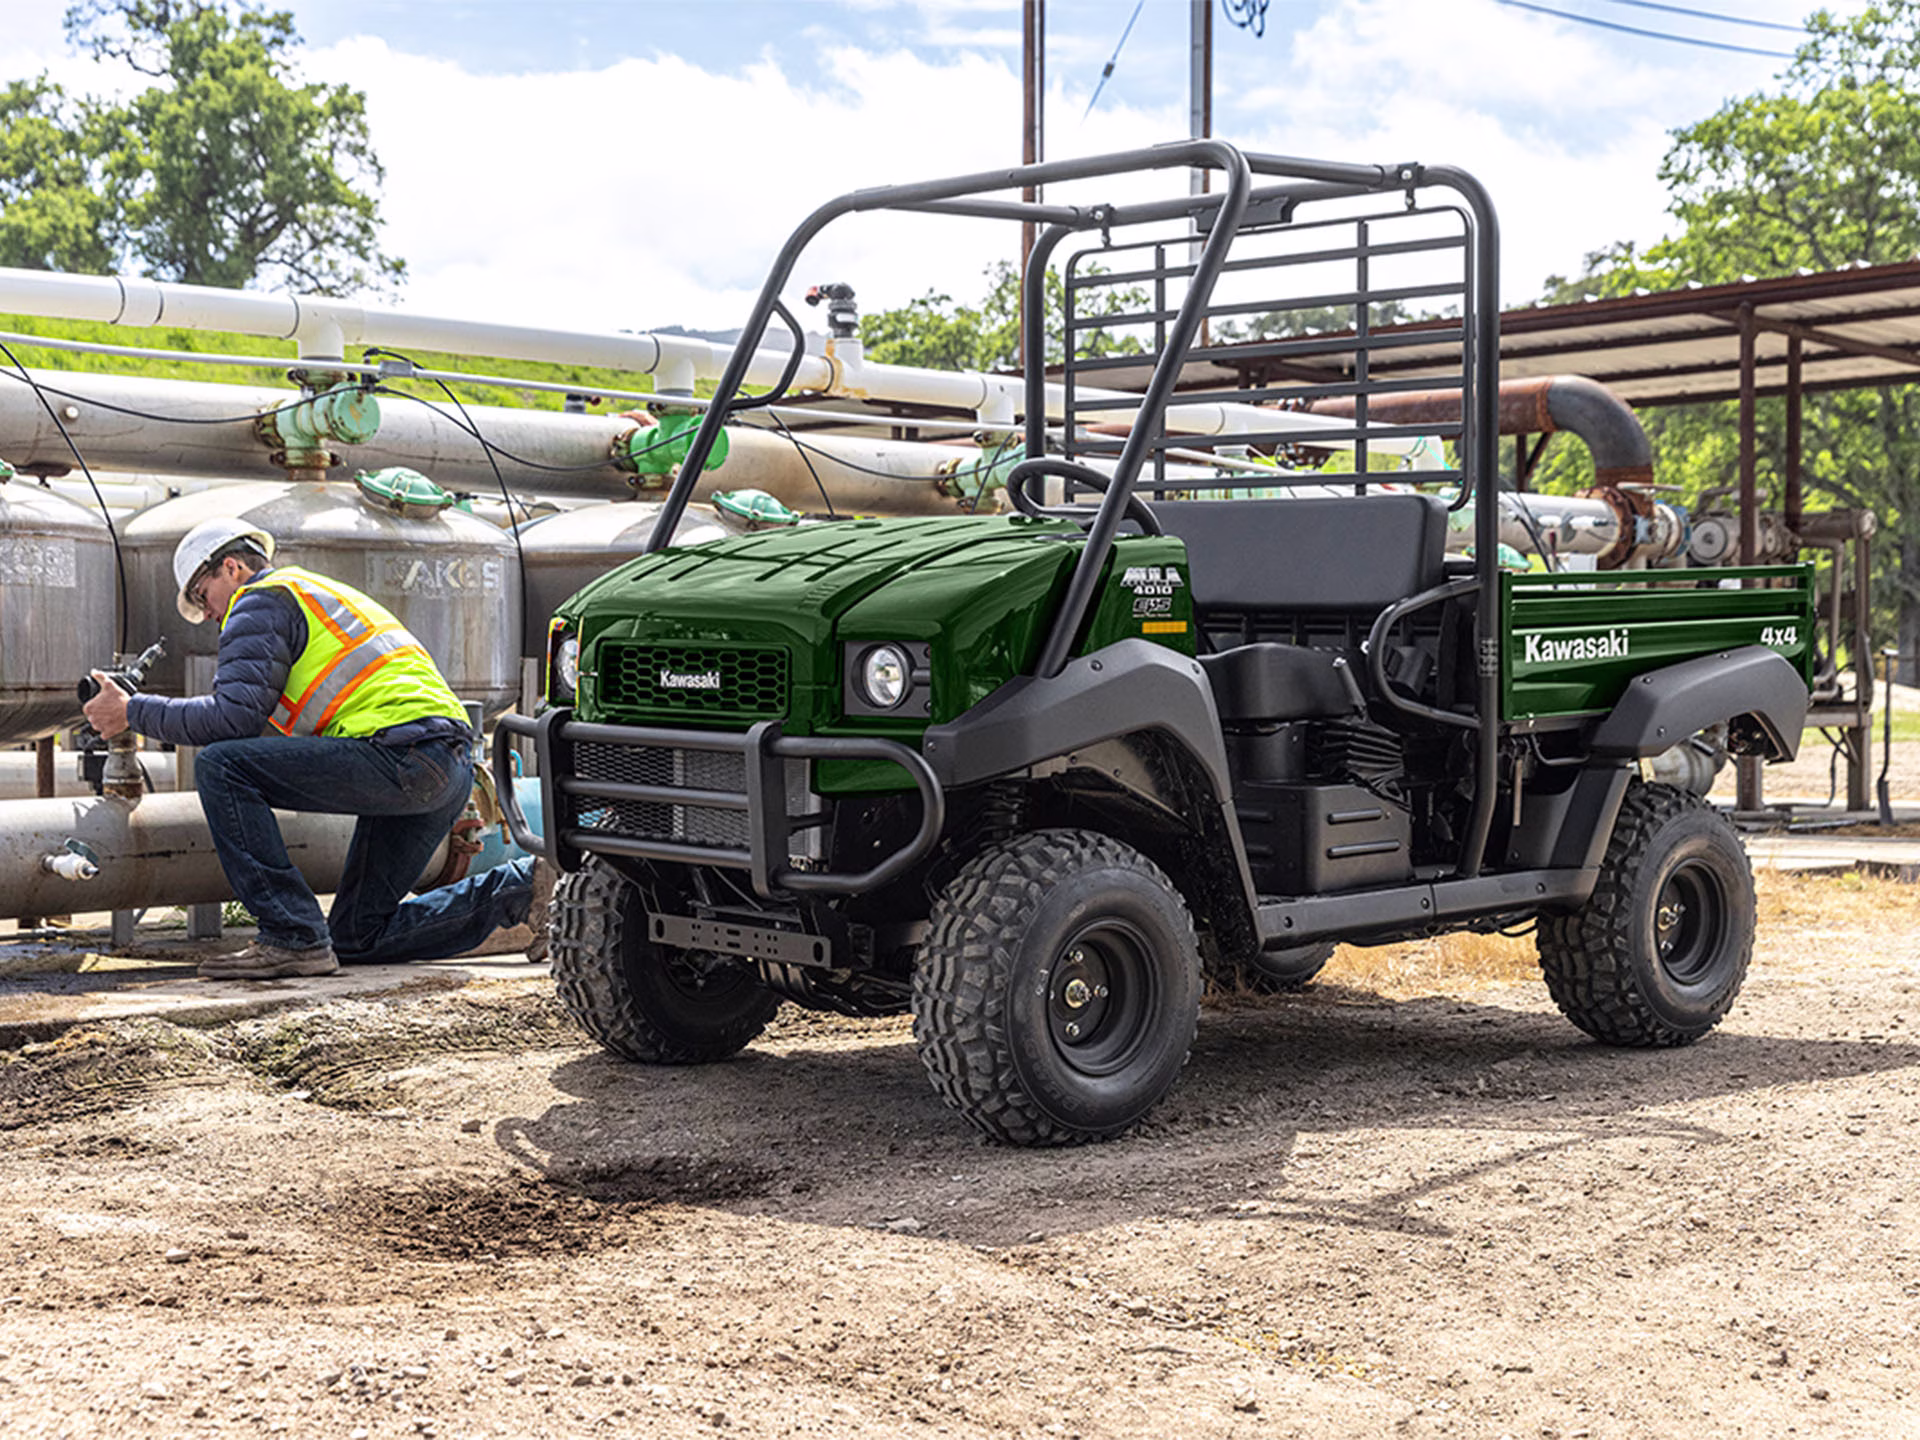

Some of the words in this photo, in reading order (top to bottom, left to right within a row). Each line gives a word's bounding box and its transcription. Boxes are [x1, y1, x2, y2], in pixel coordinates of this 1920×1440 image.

[1133, 585, 1173, 595] 4010
[1524, 628, 1629, 664] Kawasaki
[1760, 625, 1798, 646] 4x4
[659, 668, 721, 690] Kawasaki
